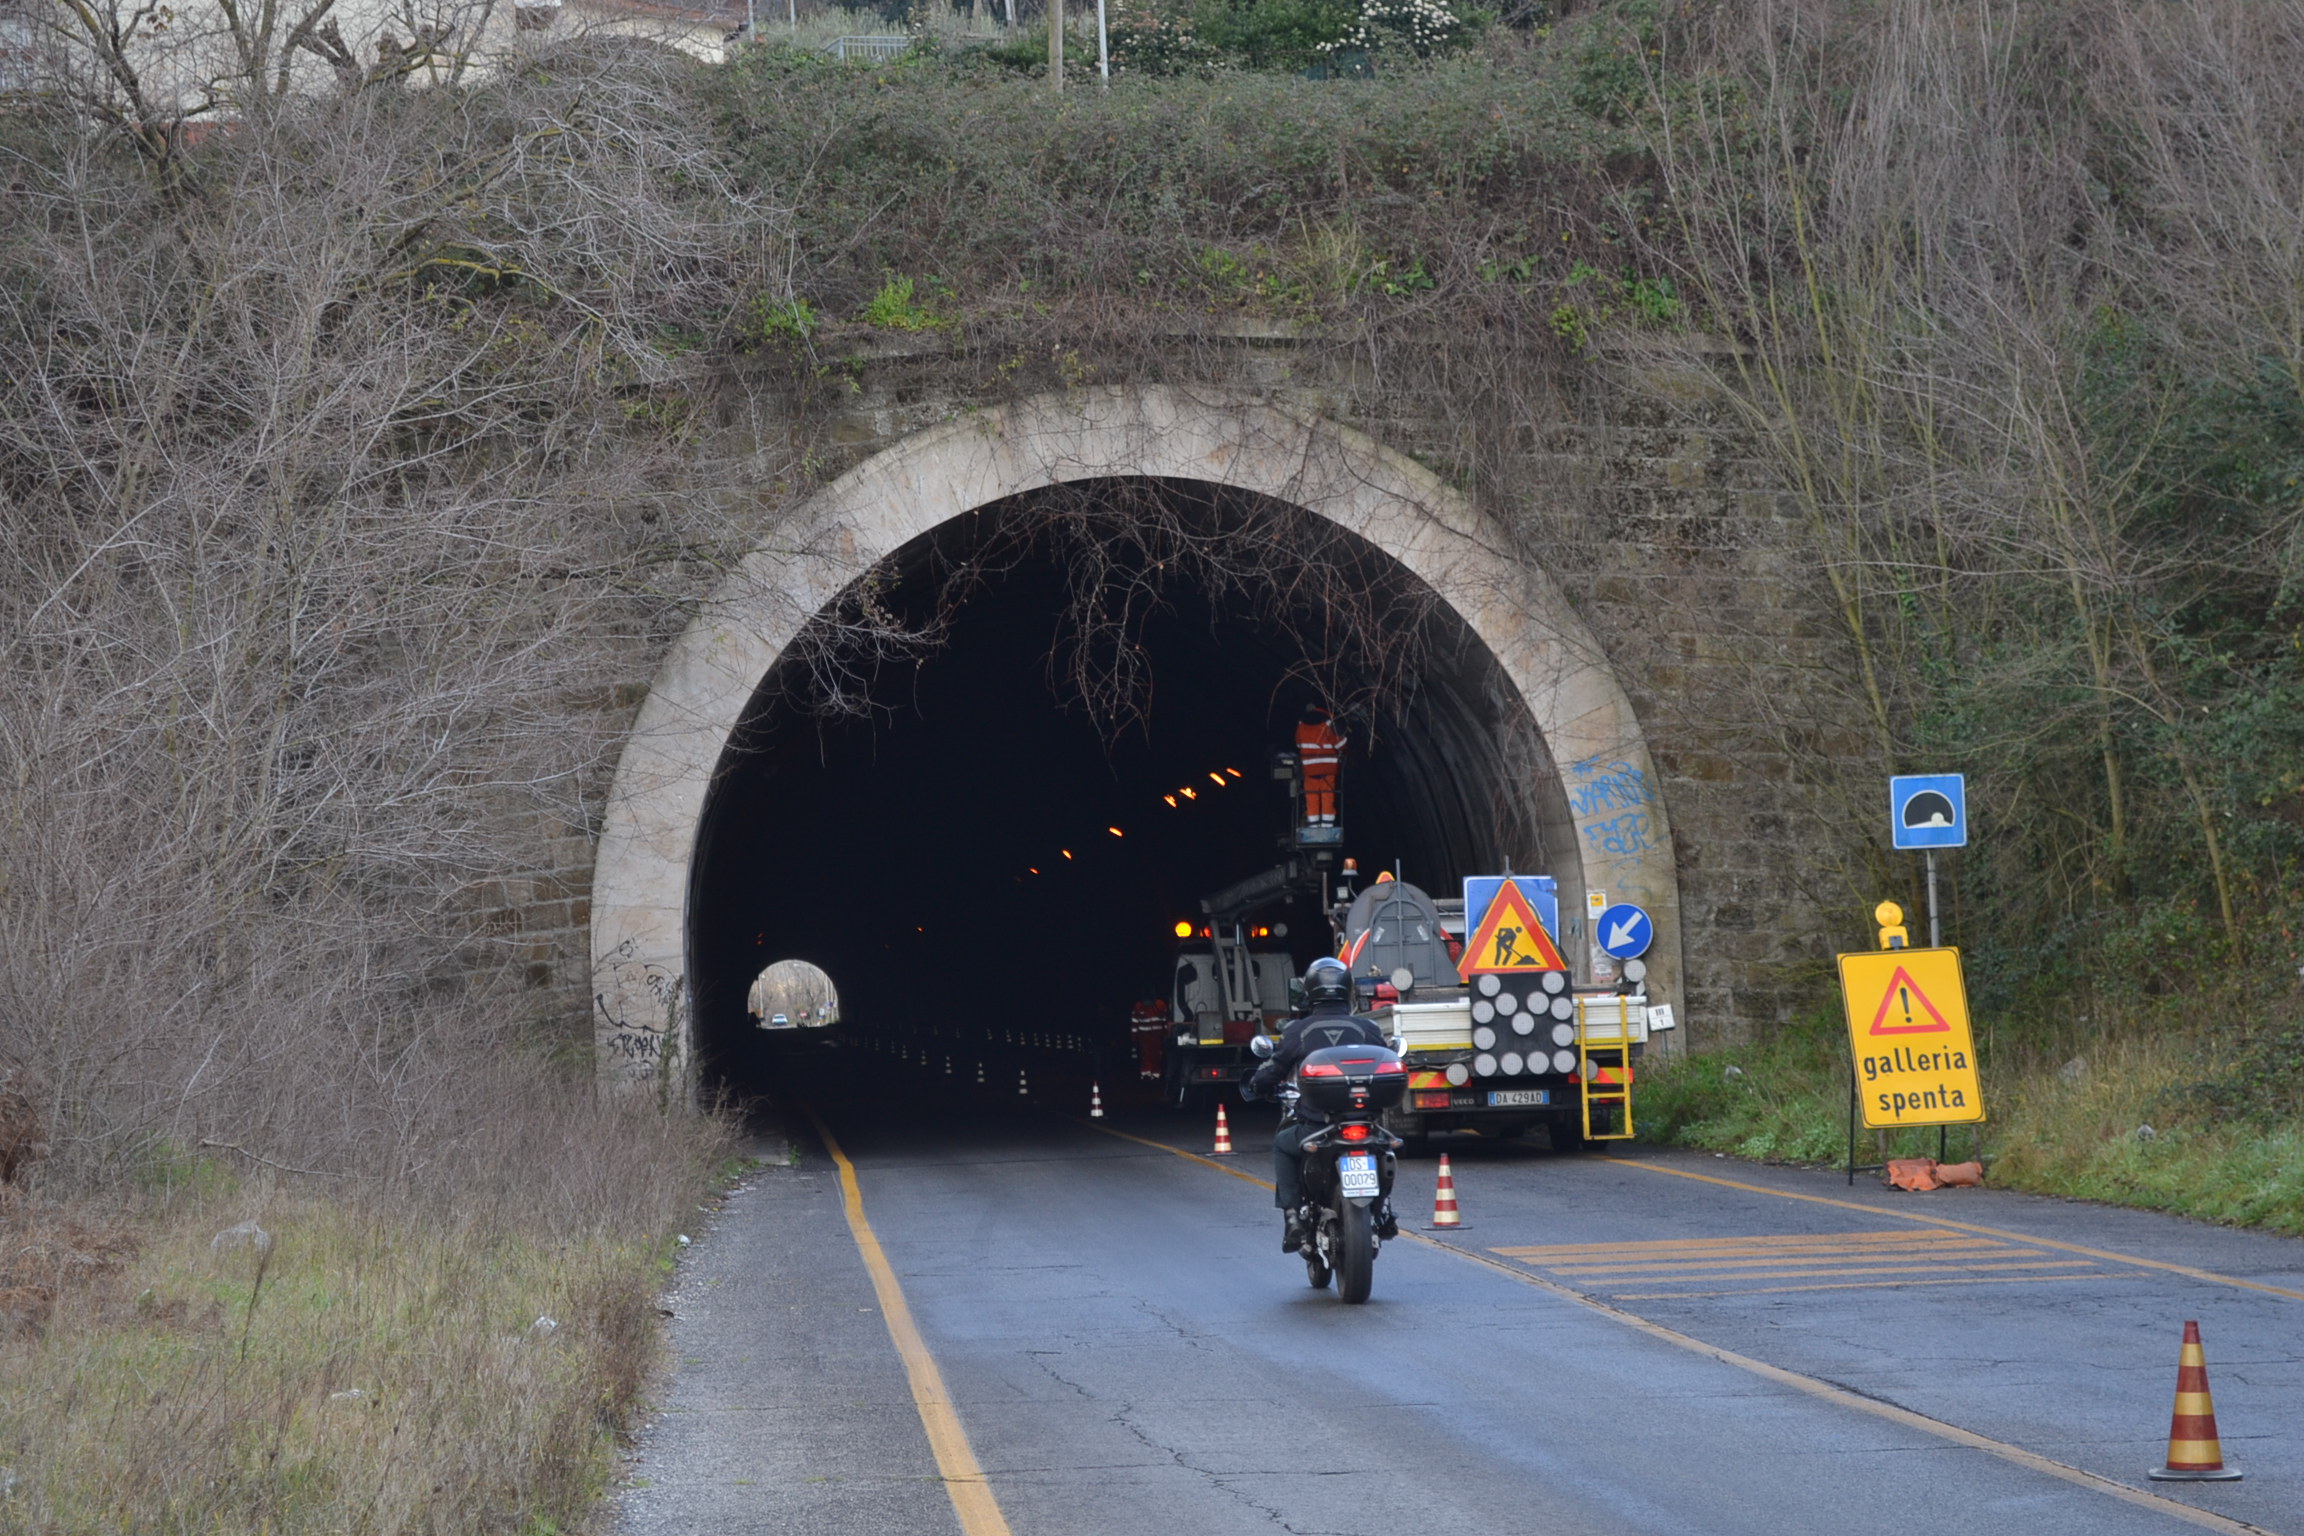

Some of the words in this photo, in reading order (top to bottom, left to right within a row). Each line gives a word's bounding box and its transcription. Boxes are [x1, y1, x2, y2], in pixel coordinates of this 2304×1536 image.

[1863, 1045, 1967, 1081] galleria
[1878, 1084, 1966, 1118] spenta
[1344, 1173, 1376, 1186] 00079
